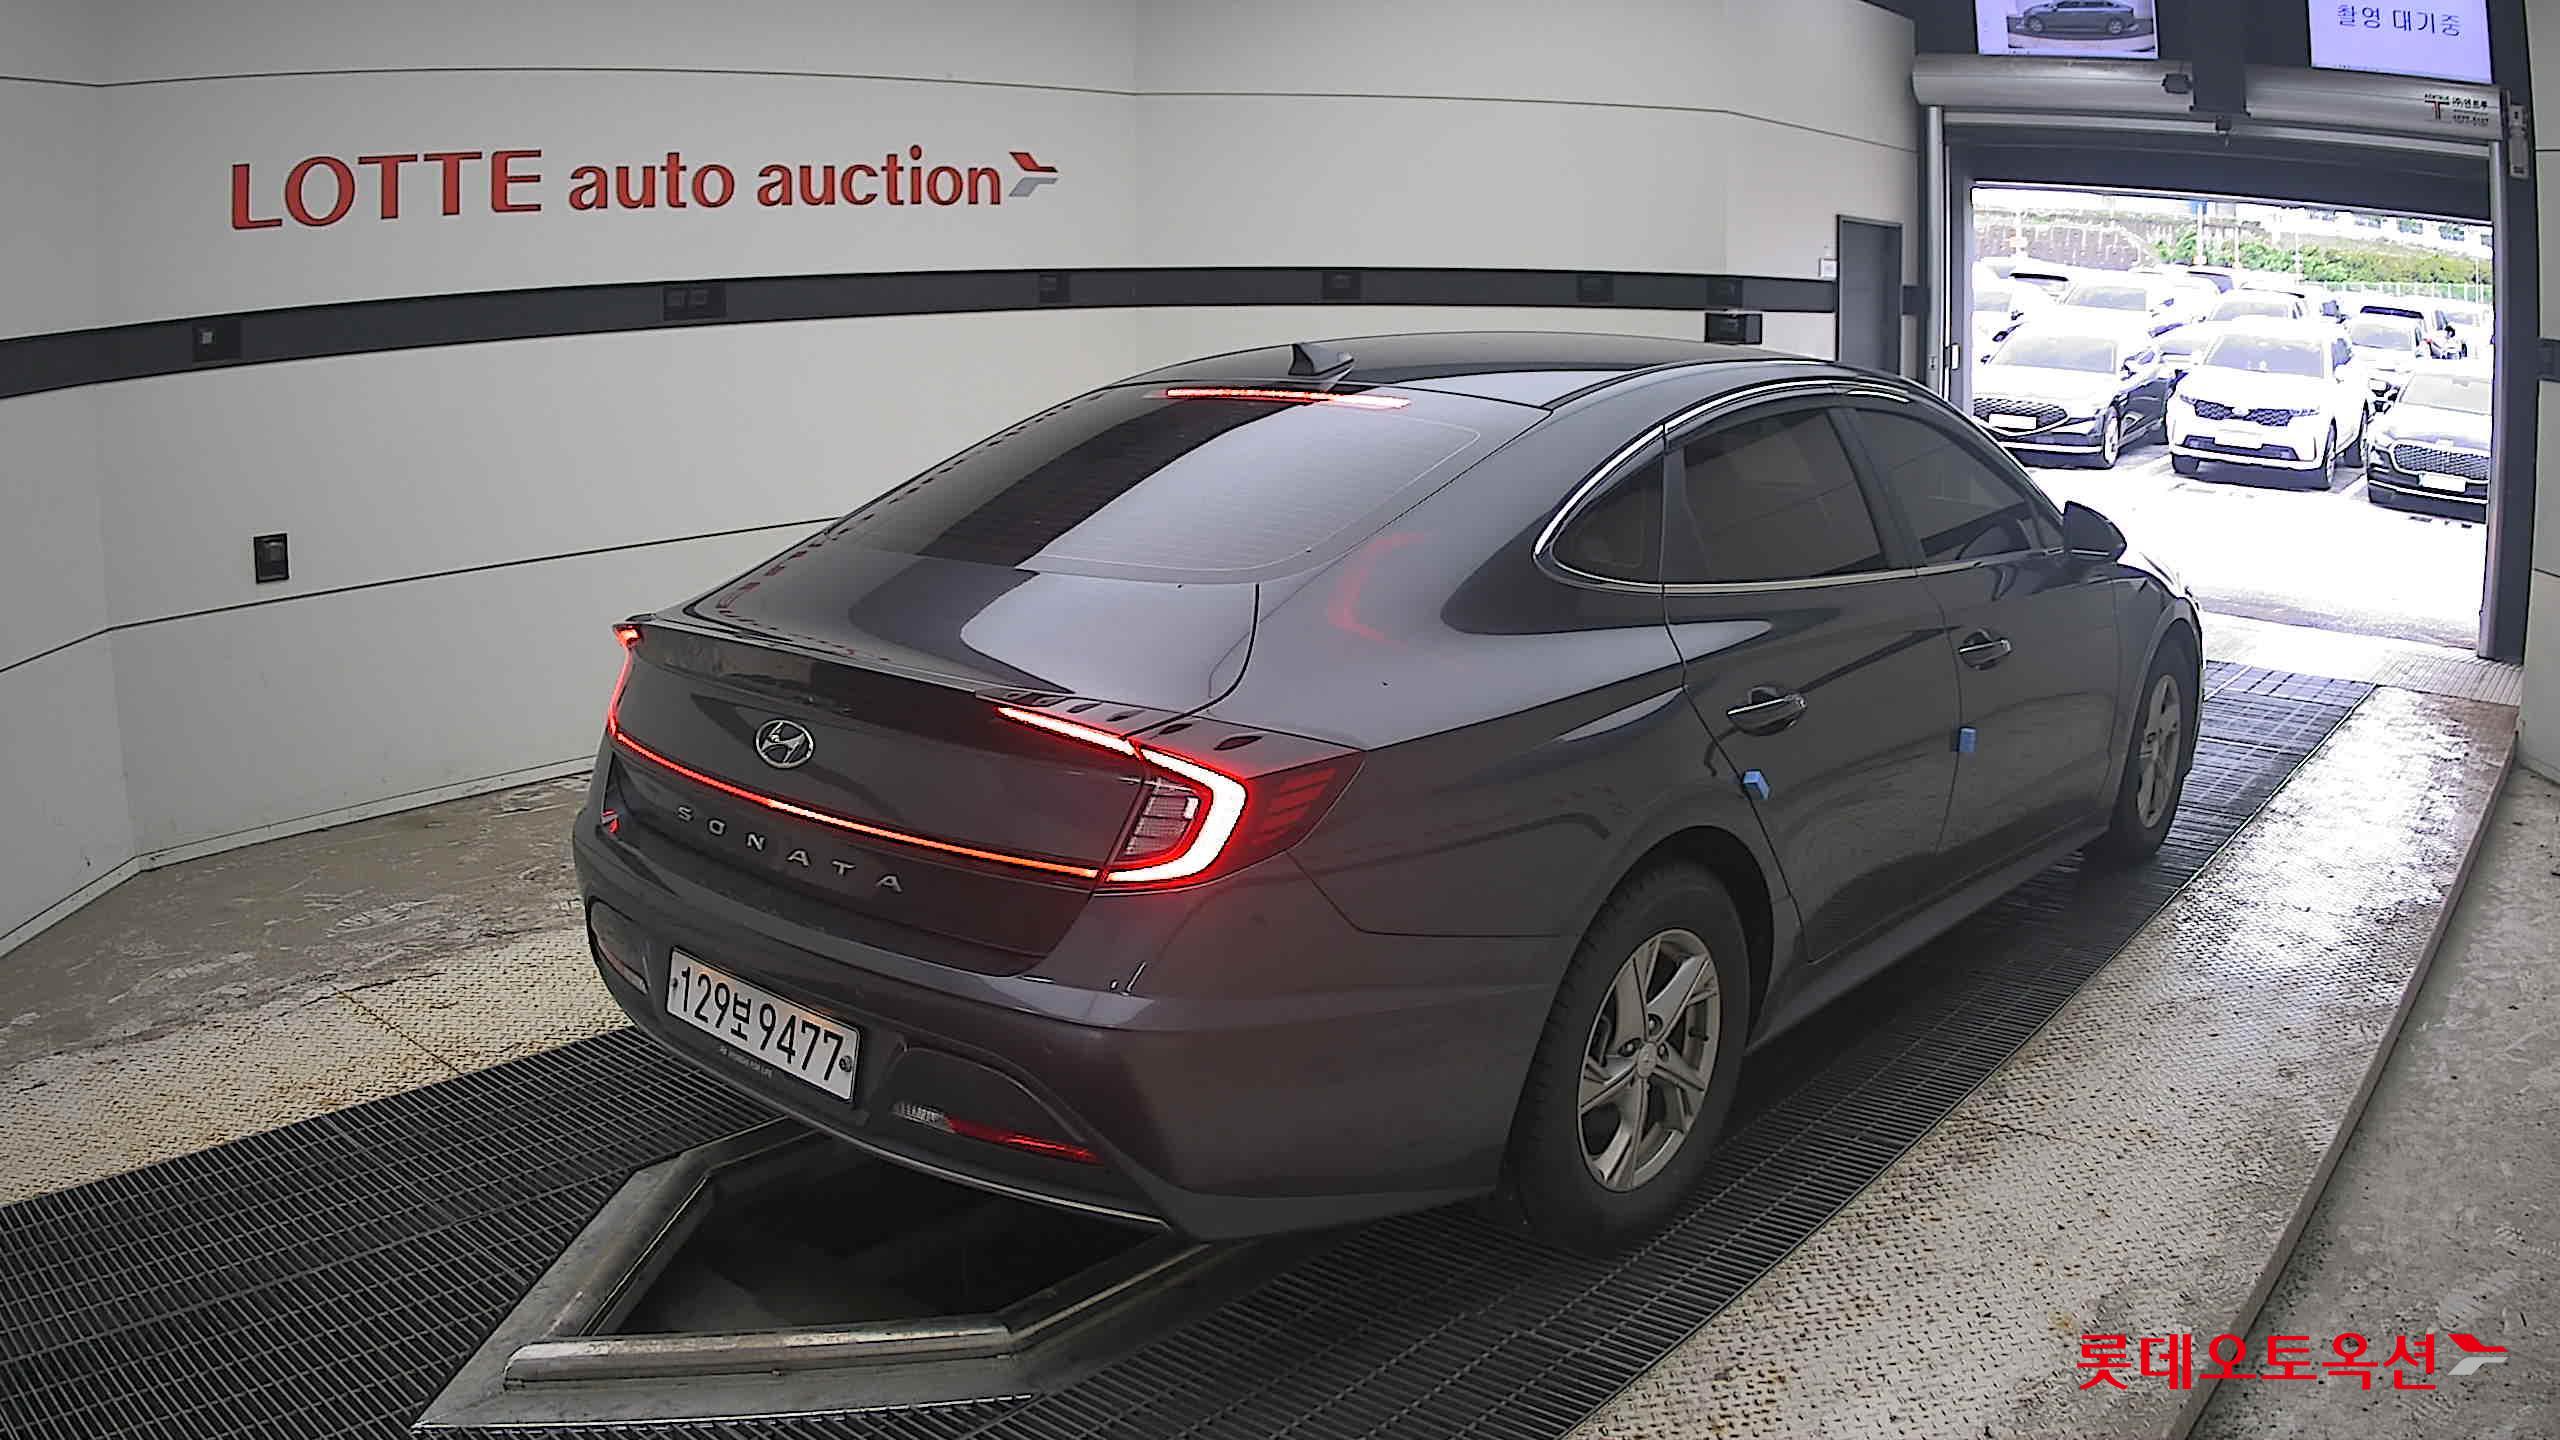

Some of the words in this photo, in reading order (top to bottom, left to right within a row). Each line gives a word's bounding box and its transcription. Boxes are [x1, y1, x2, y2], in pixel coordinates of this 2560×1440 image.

[2337, 4, 2382, 29] 촬영
[2392, 9, 2462, 37] 대기중
[232, 150, 542, 230] LOTTE
[568, 151, 736, 210] auto
[757, 144, 1002, 207] auction
[677, 806, 903, 892] SONATA
[681, 966, 844, 1081] 129보9477
